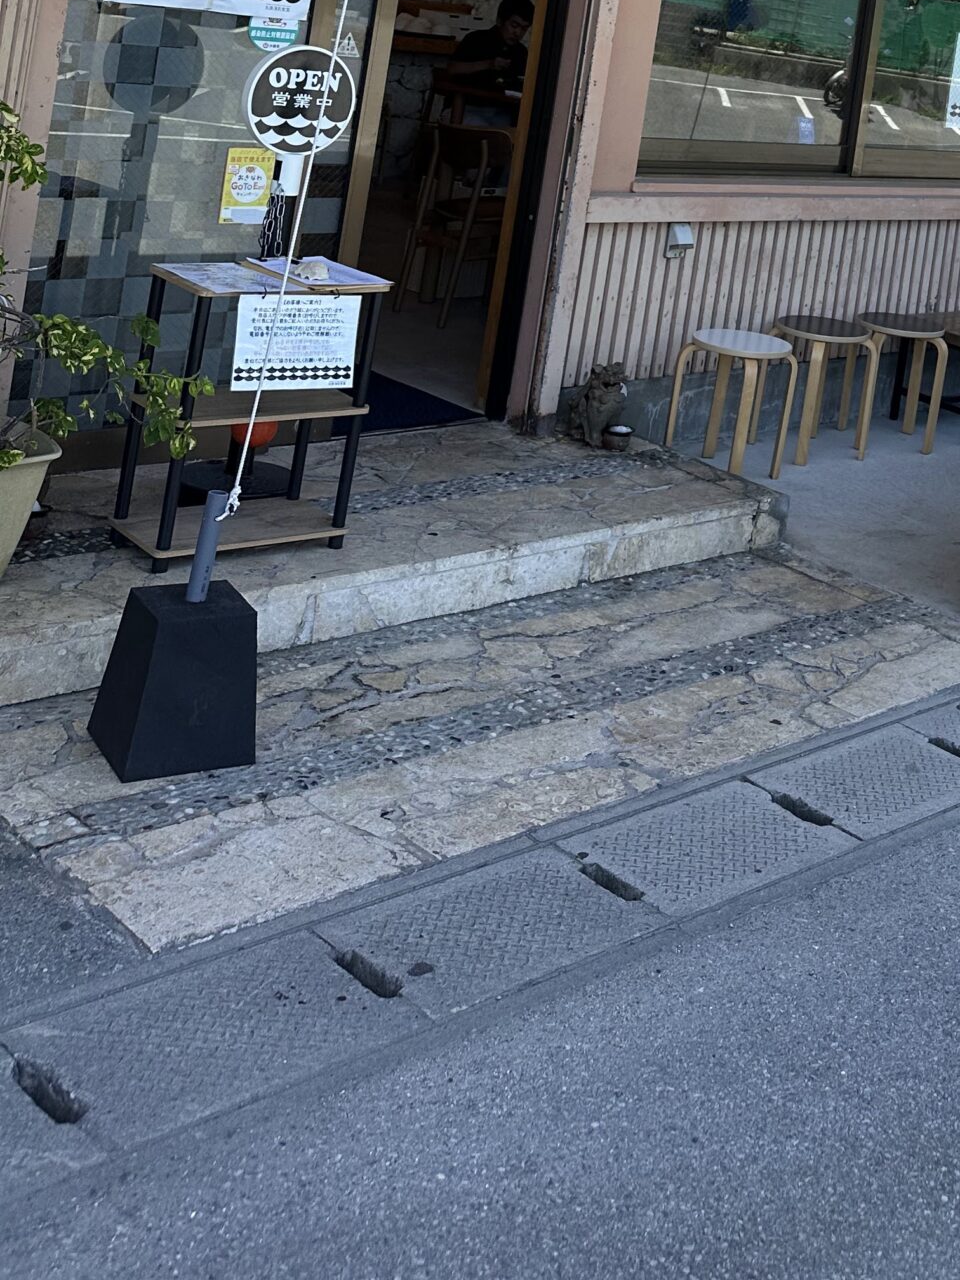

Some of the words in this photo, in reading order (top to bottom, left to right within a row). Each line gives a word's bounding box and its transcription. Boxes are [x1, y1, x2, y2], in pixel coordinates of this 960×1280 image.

[269, 67, 342, 93] OPEN
[271, 91, 333, 109] 営業中
